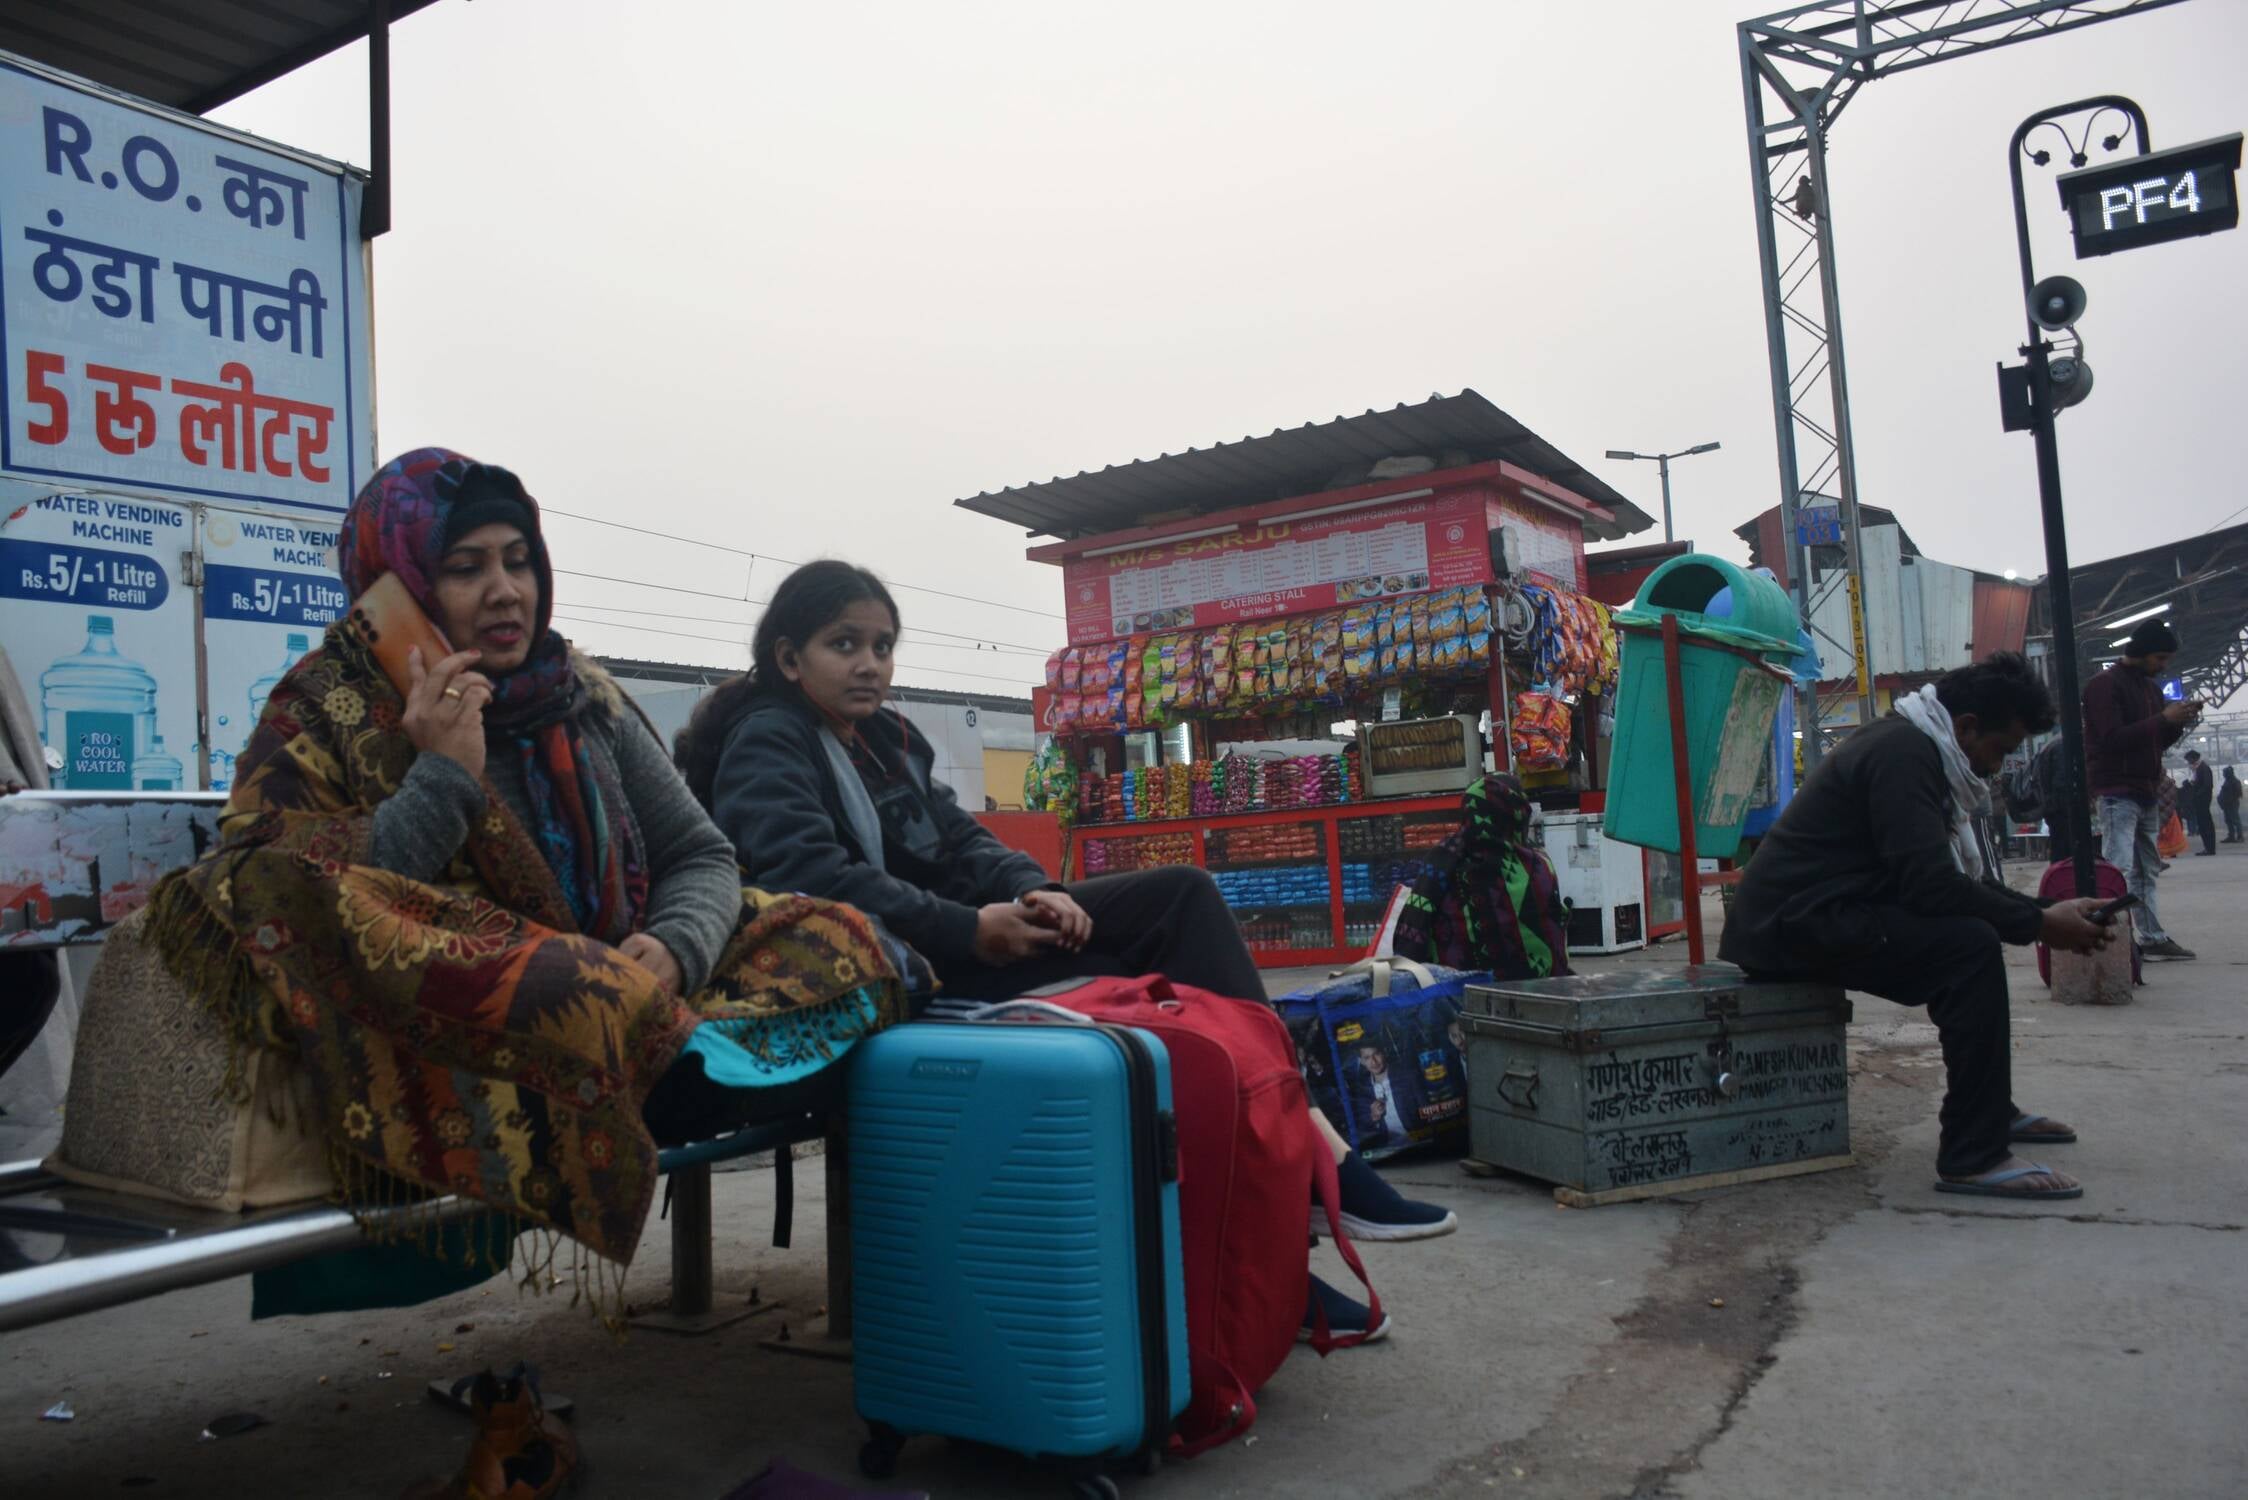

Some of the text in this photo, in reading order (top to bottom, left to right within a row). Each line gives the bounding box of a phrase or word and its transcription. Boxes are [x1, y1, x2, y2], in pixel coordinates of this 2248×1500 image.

[43, 106, 309, 240] R.O. का
[2100, 170, 2200, 230] PF4
[25, 209, 328, 359] ठंडा पानी
[26, 350, 69, 445] 5
[171, 362, 335, 483] लीटर
[36, 495, 183, 527] WATER VENDING
[73, 520, 153, 546] MACHINE
[241, 522, 295, 543] WATER
[113, 562, 157, 588] Litre
[107, 588, 147, 604] Refill
[307, 584, 345, 608] Litre
[1221, 588, 1307, 610] CATERING STALL
[303, 608, 336, 622] Refill
[2163, 682, 2175, 696] 4
[91, 732, 112, 745] RO
[81, 746, 121, 758] COOL
[75, 759, 126, 773] WATER
